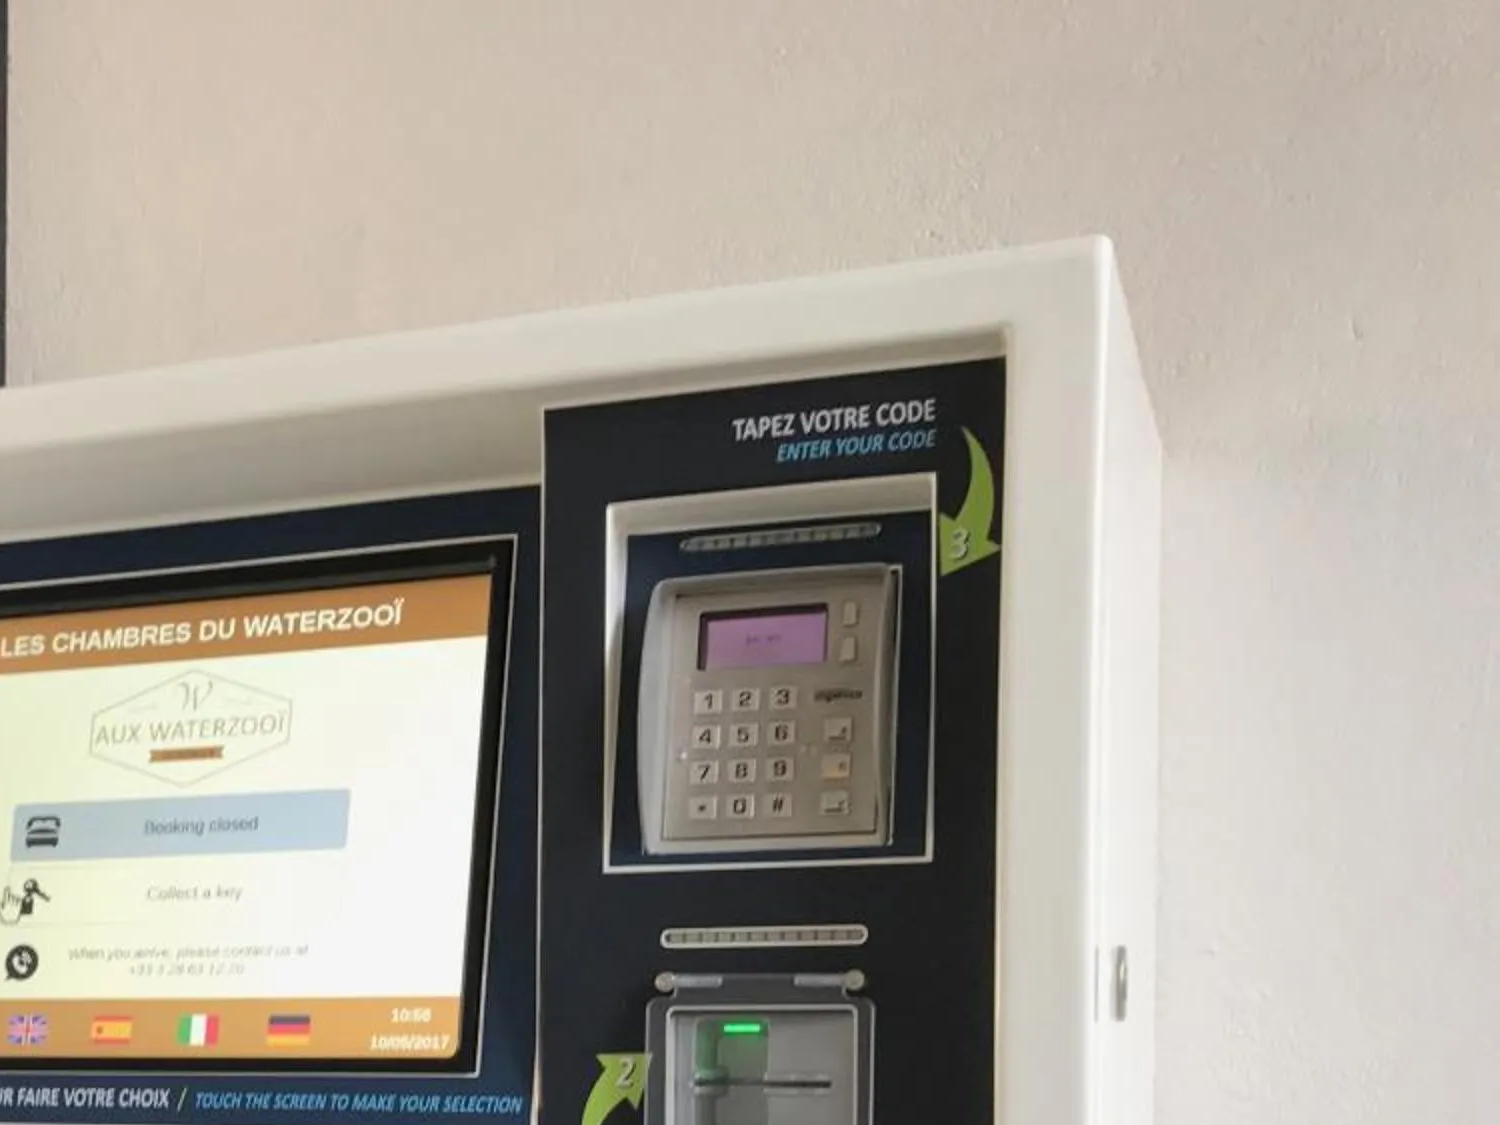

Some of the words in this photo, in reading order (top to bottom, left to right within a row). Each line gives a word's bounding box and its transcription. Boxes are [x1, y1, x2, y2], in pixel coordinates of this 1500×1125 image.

[732, 413, 795, 441] TAPEZ
[800, 404, 870, 434] VOTRE
[876, 398, 937, 426] CODE
[777, 438, 831, 463] ENTER
[835, 433, 884, 456] YOUR
[888, 428, 937, 451] CODE
[950, 528, 970, 560] 3
[0, 634, 46, 658] LES
[52, 622, 192, 654] CHAMBRES
[200, 618, 236, 641] DU
[244, 598, 405, 637] WATERZOOÏ
[738, 690, 752, 708] 2
[776, 688, 790, 706] 3
[94, 722, 142, 746] AUX
[149, 711, 287, 742] WATERZOOÏ
[699, 728, 712, 744] 4
[736, 726, 750, 743] 5
[775, 724, 788, 741] 6
[699, 763, 711, 781] 7
[735, 762, 749, 779] 8
[773, 759, 788, 777] 9
[732, 797, 747, 815] 0
[143, 818, 205, 836] Booking
[209, 815, 260, 832] closed
[146, 885, 199, 902] Collect
[216, 884, 244, 902] key
[68, 946, 105, 961] When
[106, 947, 132, 963] you
[175, 945, 220, 961] please
[225, 944, 273, 958] contact
[616, 1056, 636, 1087] 2
[17, 1086, 61, 1107] FAIRE
[63, 1087, 115, 1108] VOTRE
[118, 1087, 171, 1109] CHOIX
[194, 1091, 243, 1110] TOUCH
[245, 1091, 271, 1110] THE
[274, 1092, 326, 1111] SCREEN
[329, 1093, 350, 1111] TO
[351, 1093, 396, 1112] MAKE
[398, 1094, 442, 1113] YOUR
[443, 1095, 524, 1115] SELECTION
